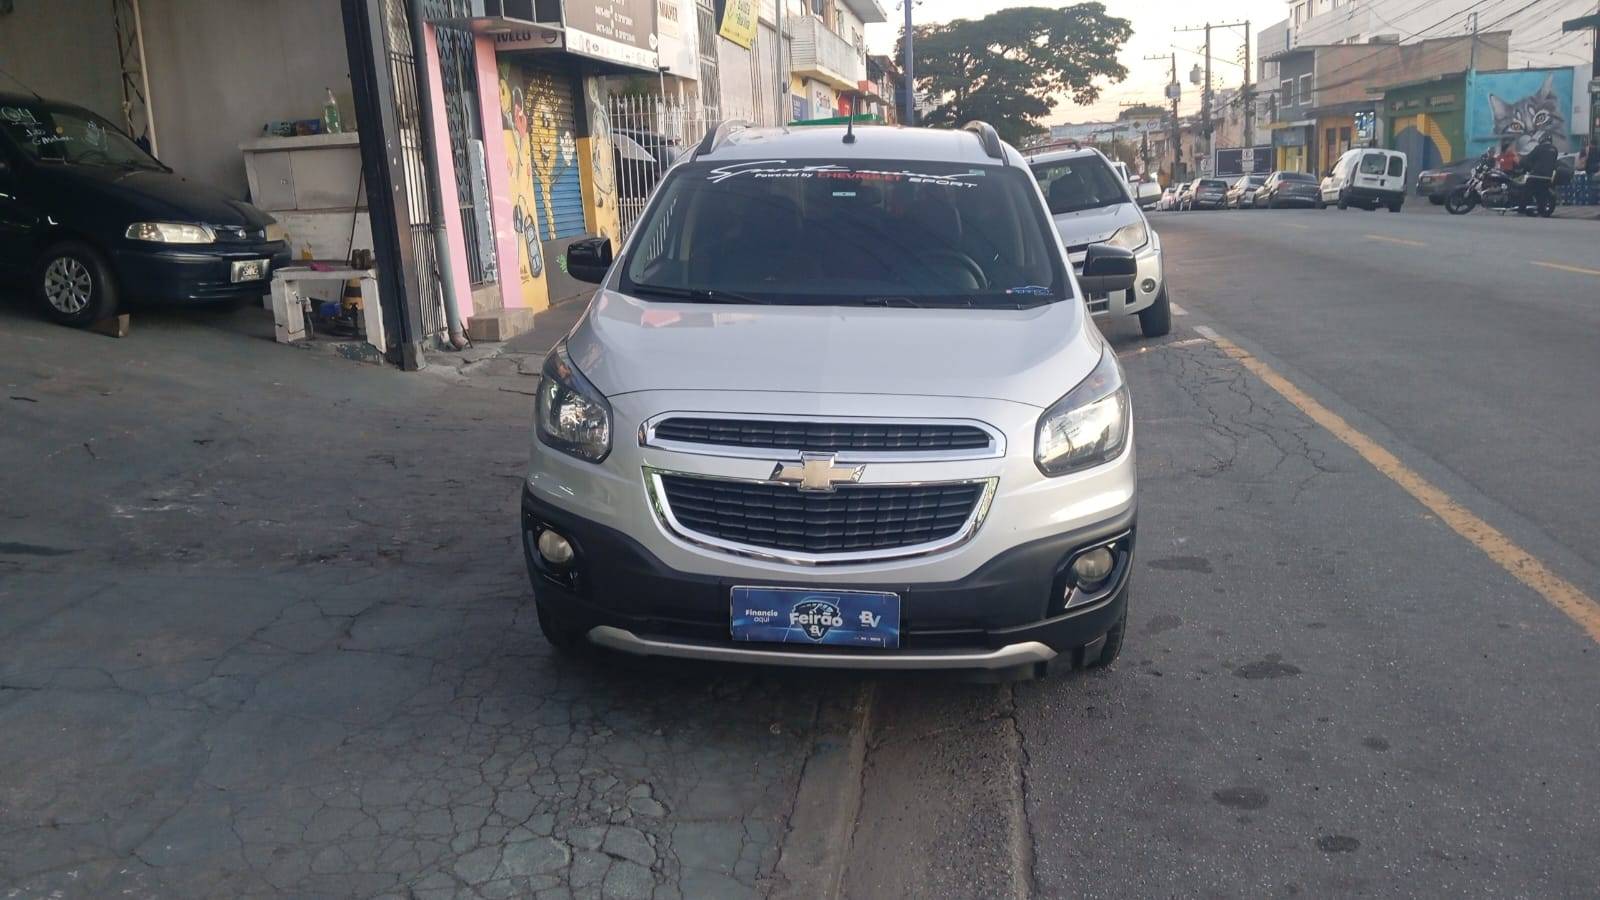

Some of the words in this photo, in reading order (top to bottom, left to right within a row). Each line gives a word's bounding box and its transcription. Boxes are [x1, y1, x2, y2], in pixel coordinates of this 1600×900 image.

[754, 171, 800, 179] Powered
[801, 171, 814, 179] by
[908, 176, 978, 189] SPORT
[753, 616, 770, 624] aqui
[789, 610, 844, 627] Feirão
[858, 610, 882, 628] BV
